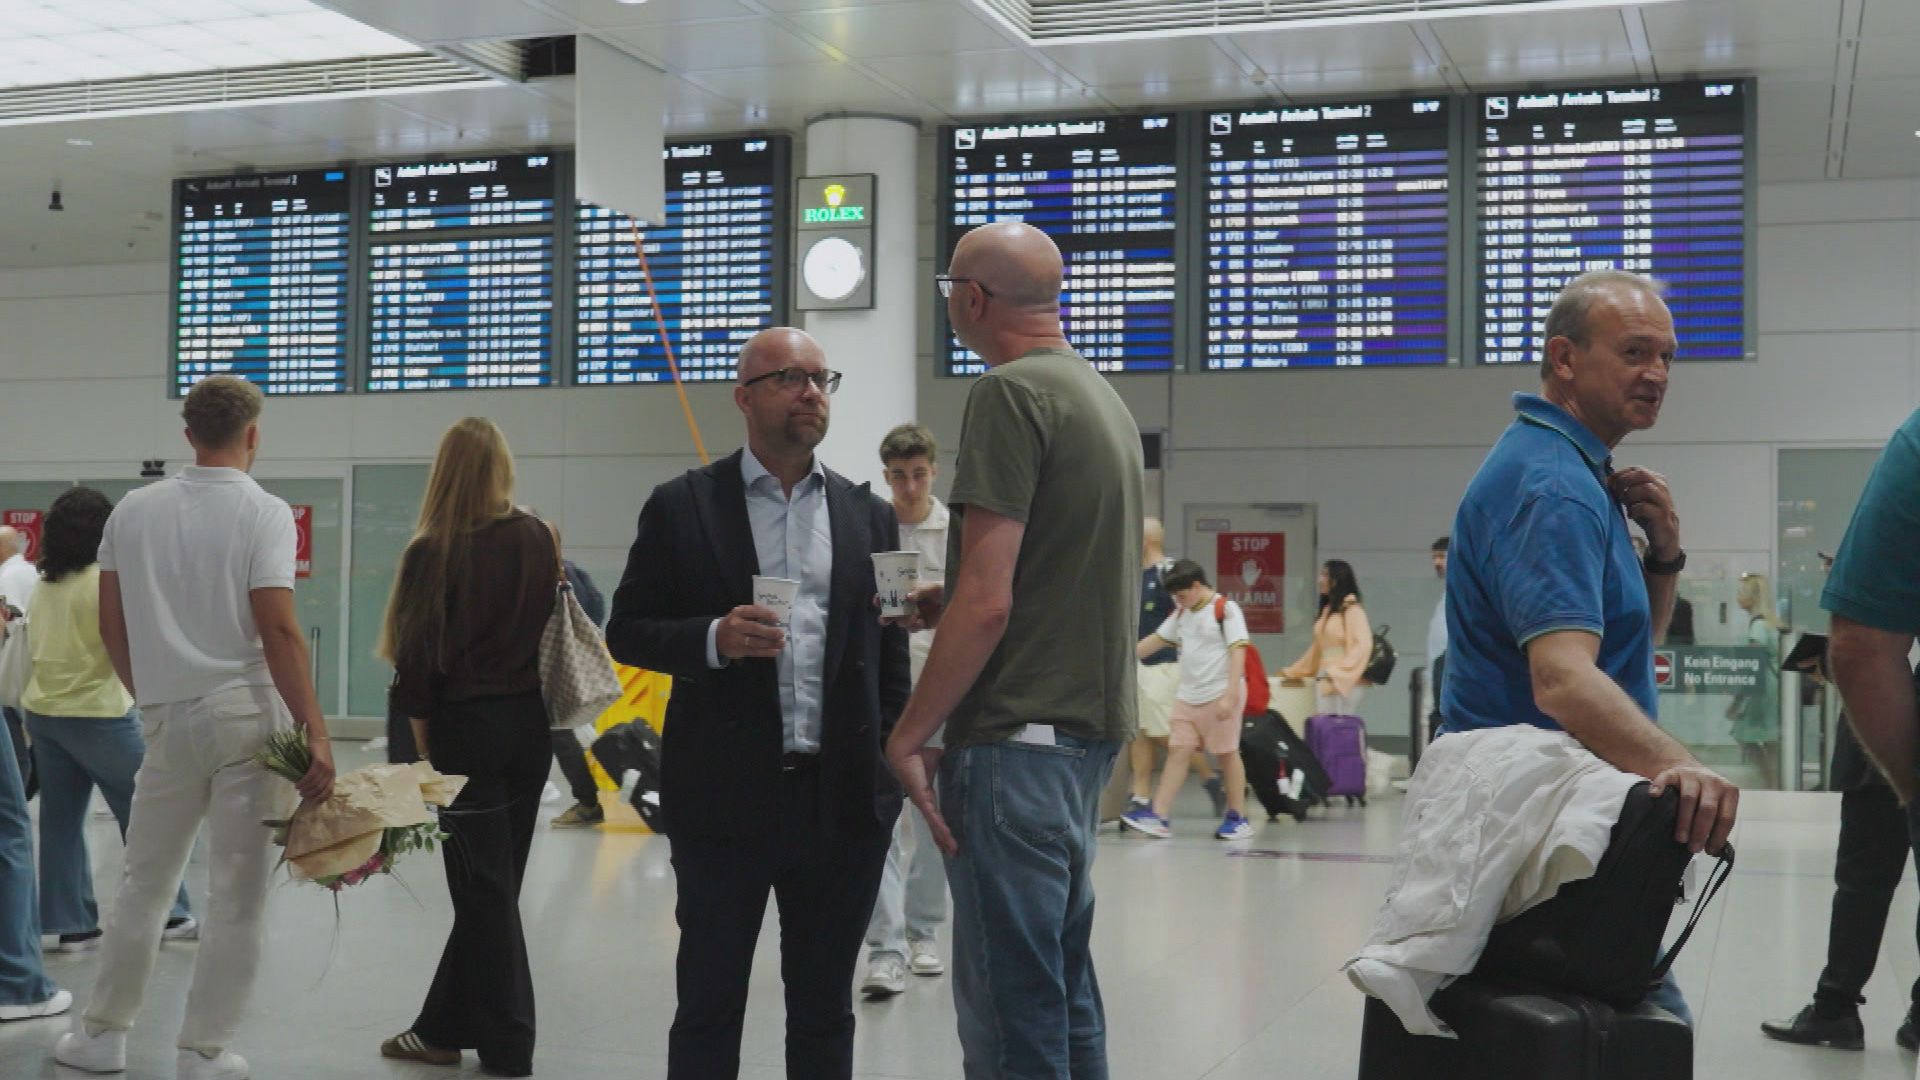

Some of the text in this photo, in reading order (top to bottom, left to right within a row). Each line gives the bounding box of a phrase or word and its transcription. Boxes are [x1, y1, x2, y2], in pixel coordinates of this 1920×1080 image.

[1653, 89, 1659, 100] 2
[1098, 121, 1104, 132] 2
[706, 145, 711, 155] 2
[804, 207, 864, 222] ROLEX
[10, 512, 37, 524] STOP
[1231, 537, 1271, 551] STOP
[1684, 656, 1759, 671] Kein Eingang
[1684, 673, 1756, 685] No Entrance
